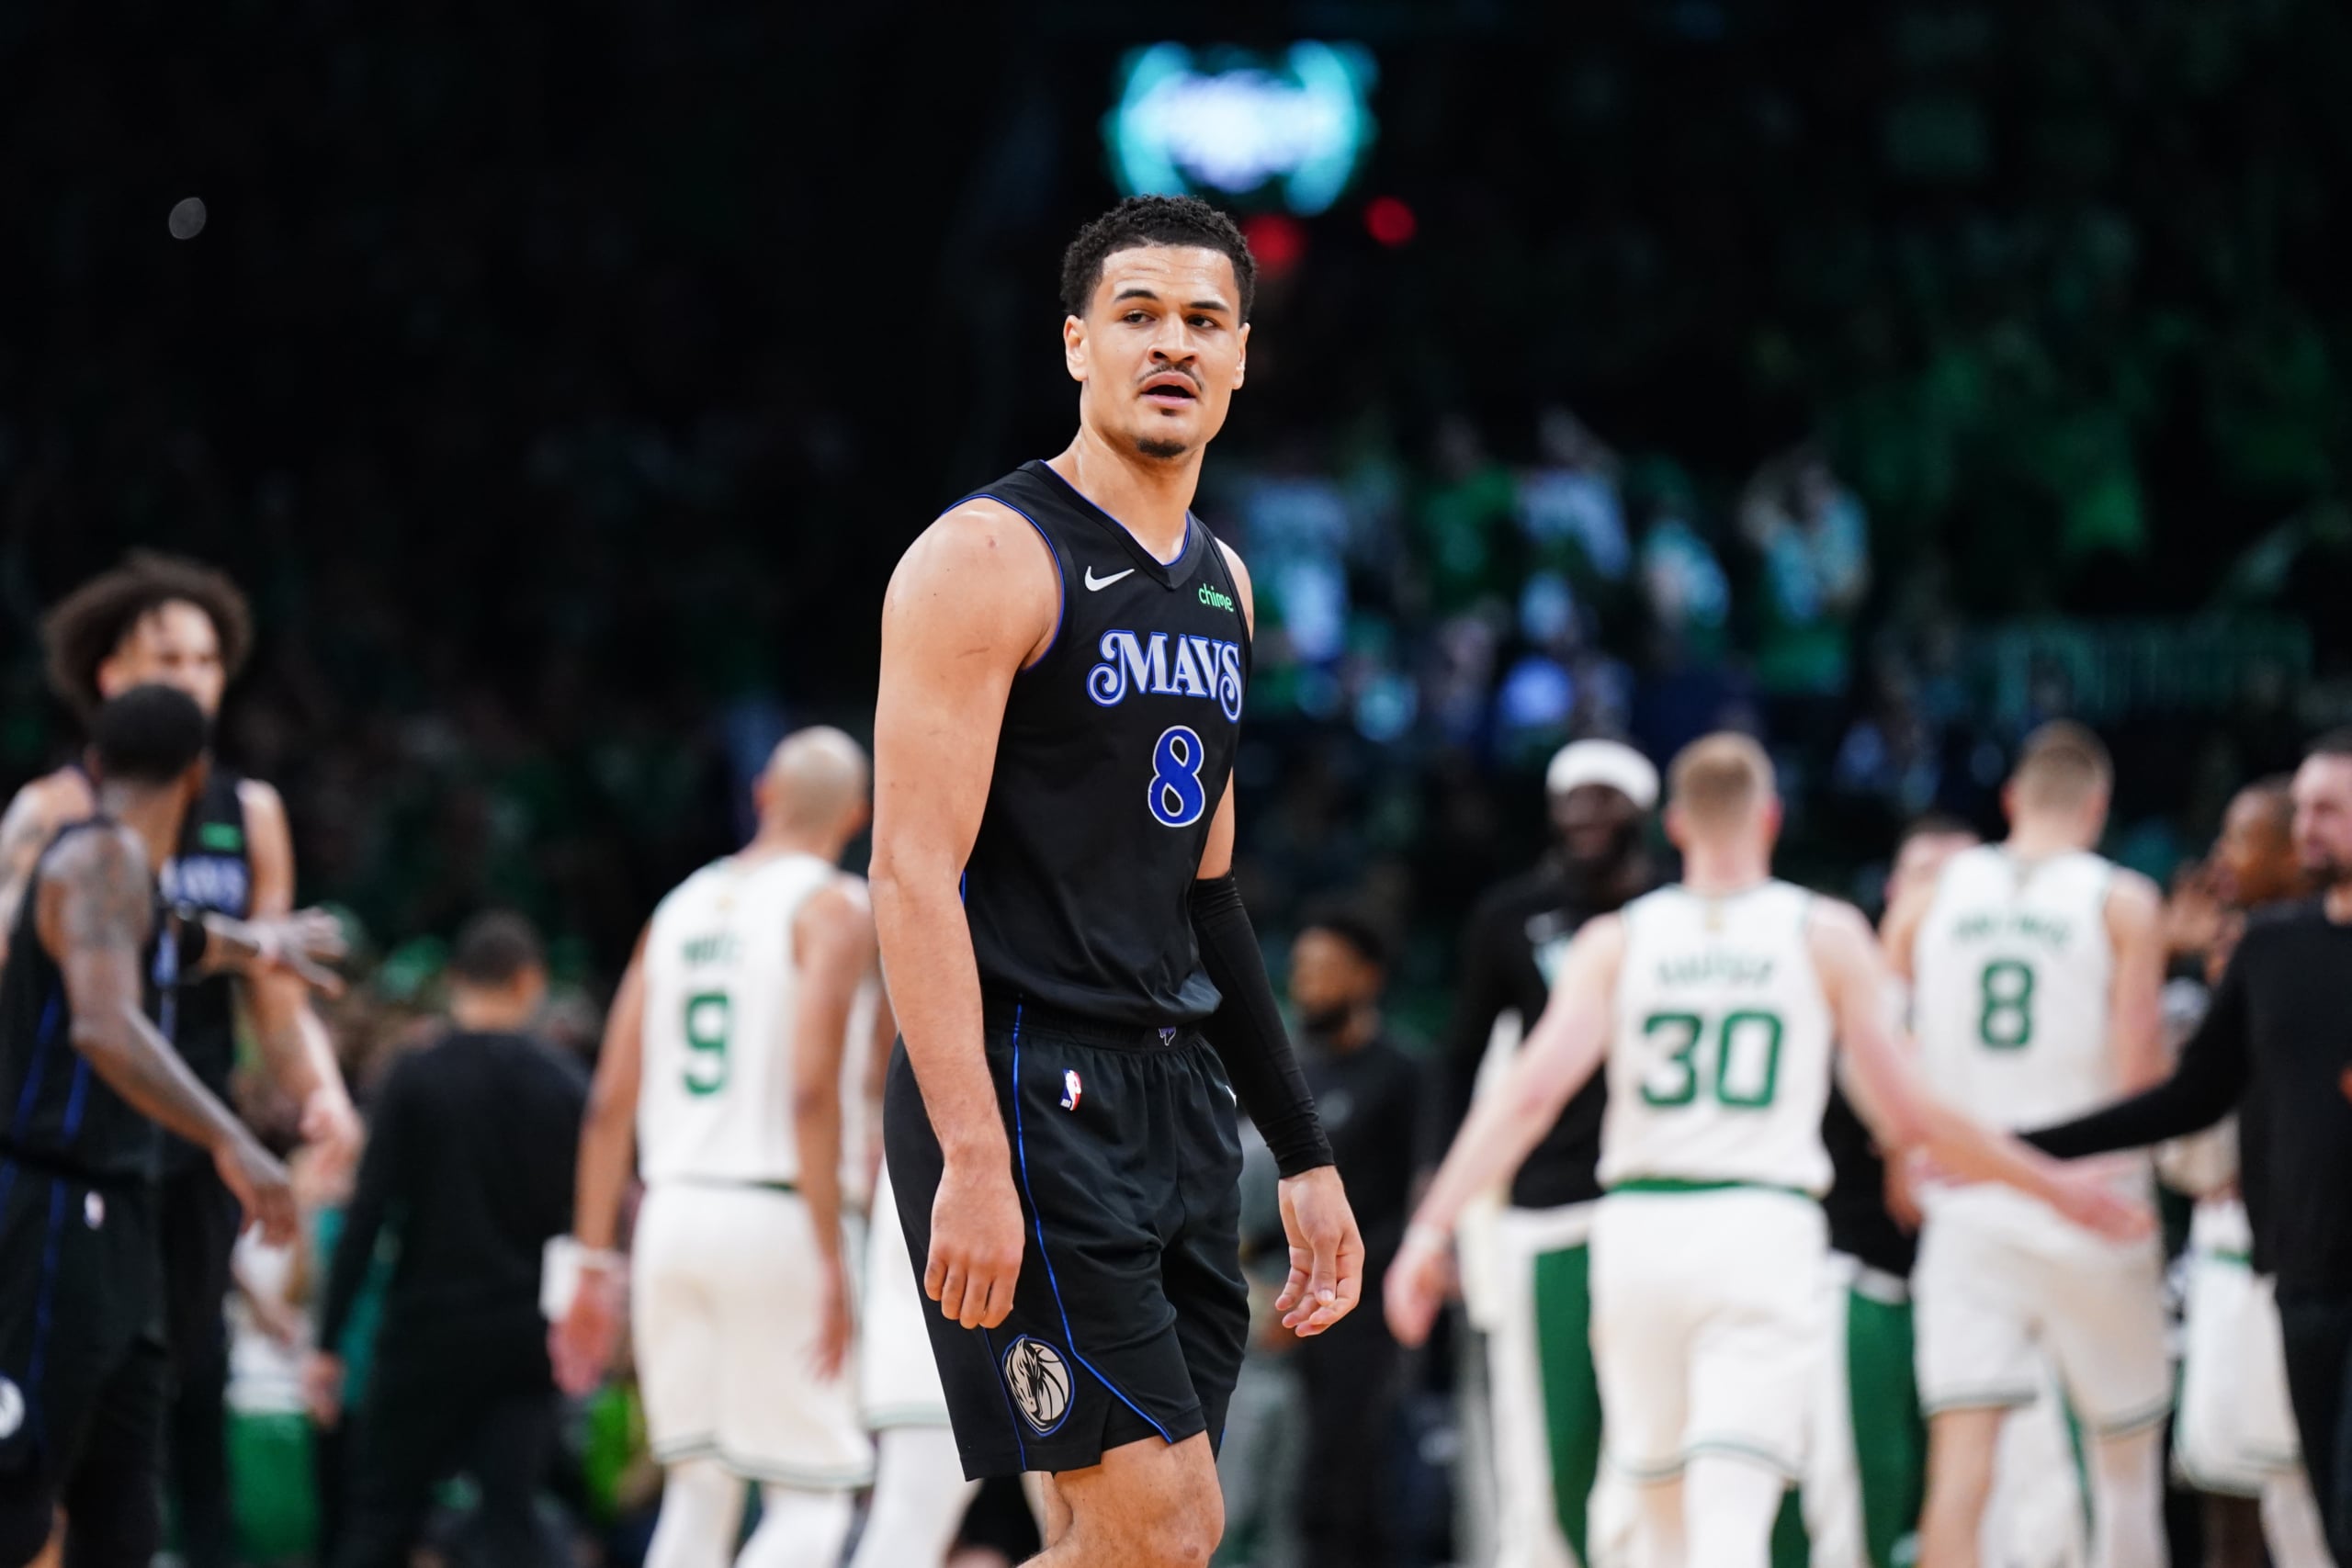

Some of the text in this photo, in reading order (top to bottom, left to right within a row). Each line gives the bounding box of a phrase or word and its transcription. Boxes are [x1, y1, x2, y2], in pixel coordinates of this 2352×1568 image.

[1198, 582, 1234, 613] chime
[1087, 629, 1241, 723] MAVS
[1148, 725, 1205, 827] 8
[683, 990, 730, 1098] 9
[1979, 960, 2033, 1049] 8
[1640, 1010, 1784, 1109] 30
